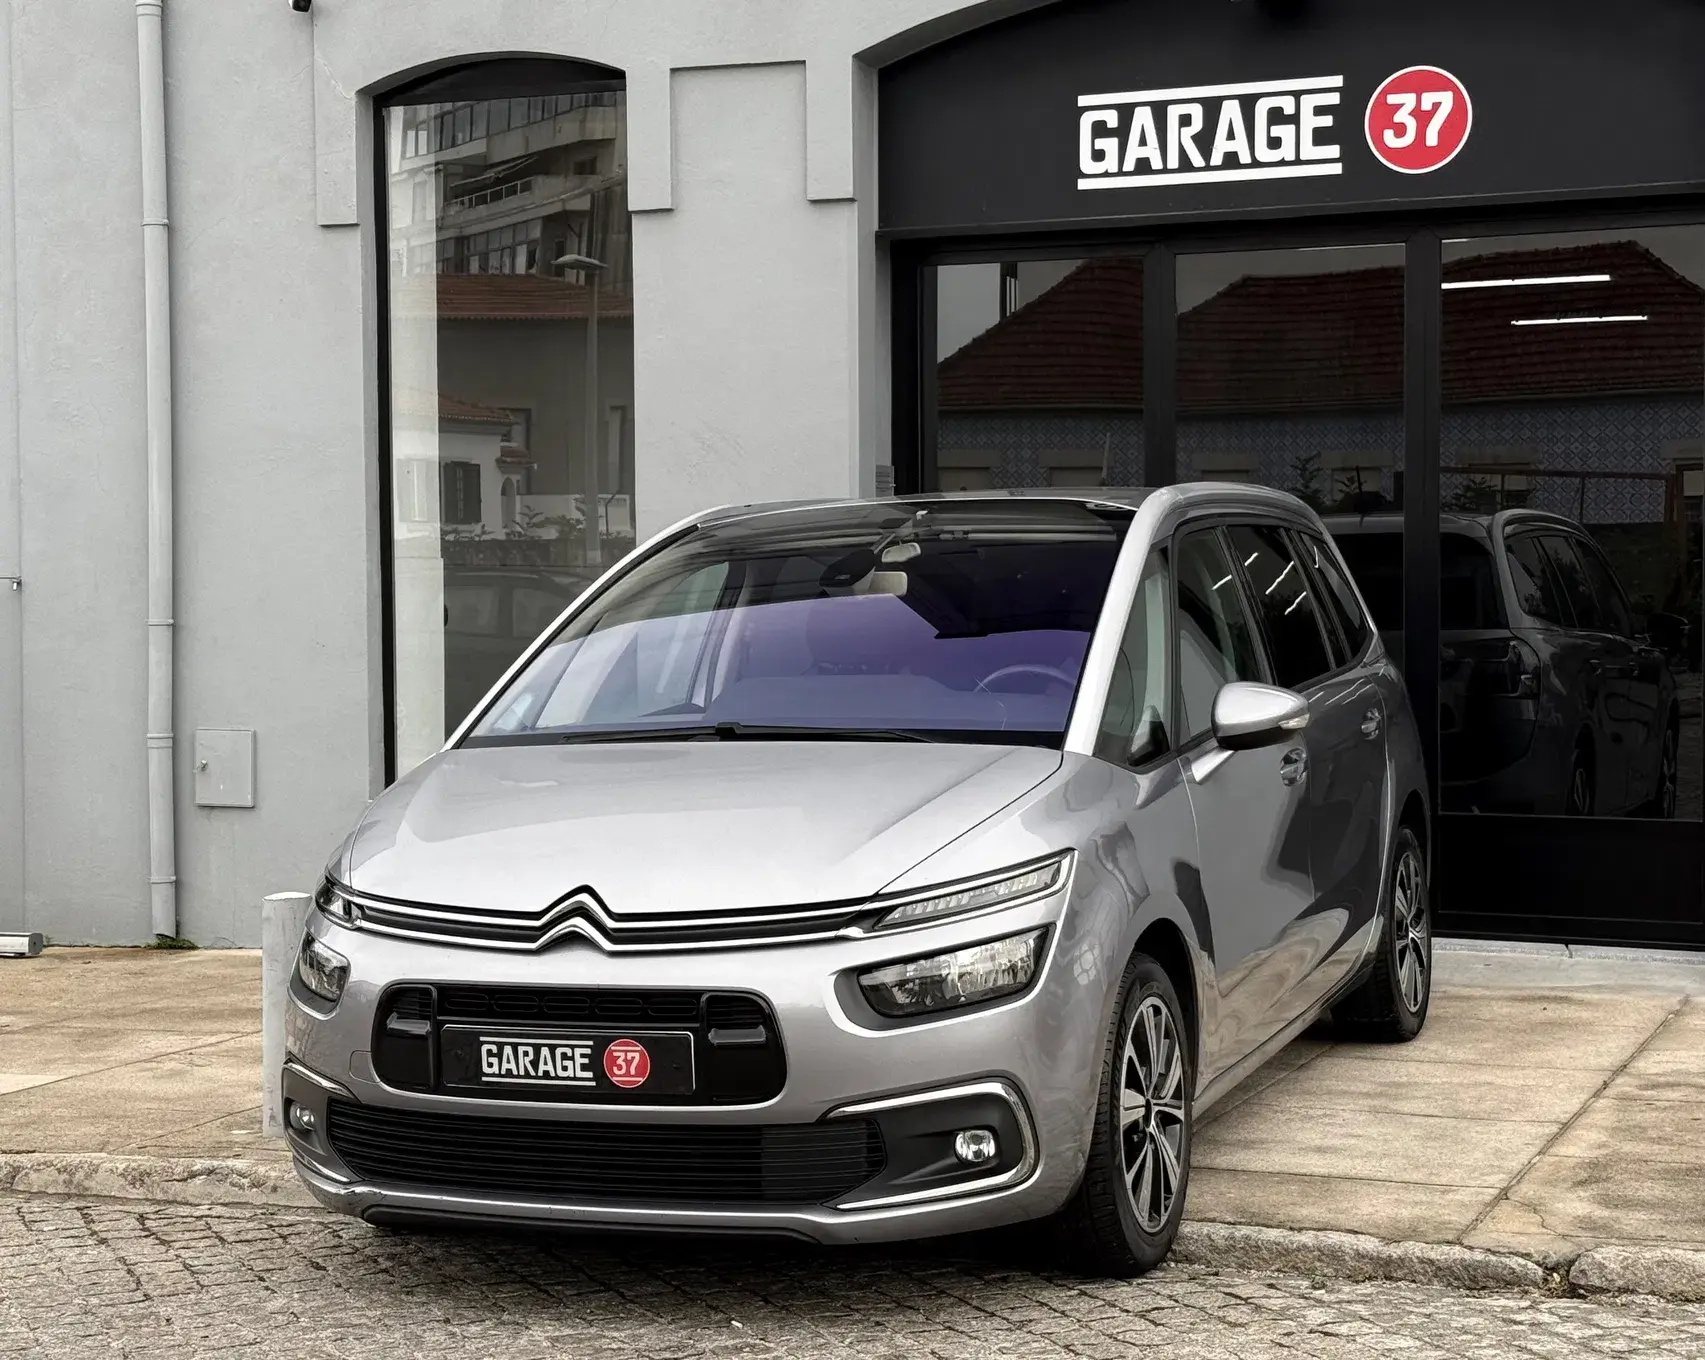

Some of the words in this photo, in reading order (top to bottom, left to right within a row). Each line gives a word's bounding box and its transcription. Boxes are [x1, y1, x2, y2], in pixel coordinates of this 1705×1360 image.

[1079, 92, 1341, 174] GARAGE
[1382, 90, 1454, 149] 37
[480, 1043, 594, 1078] GARAGE
[612, 1051, 641, 1076] 37
